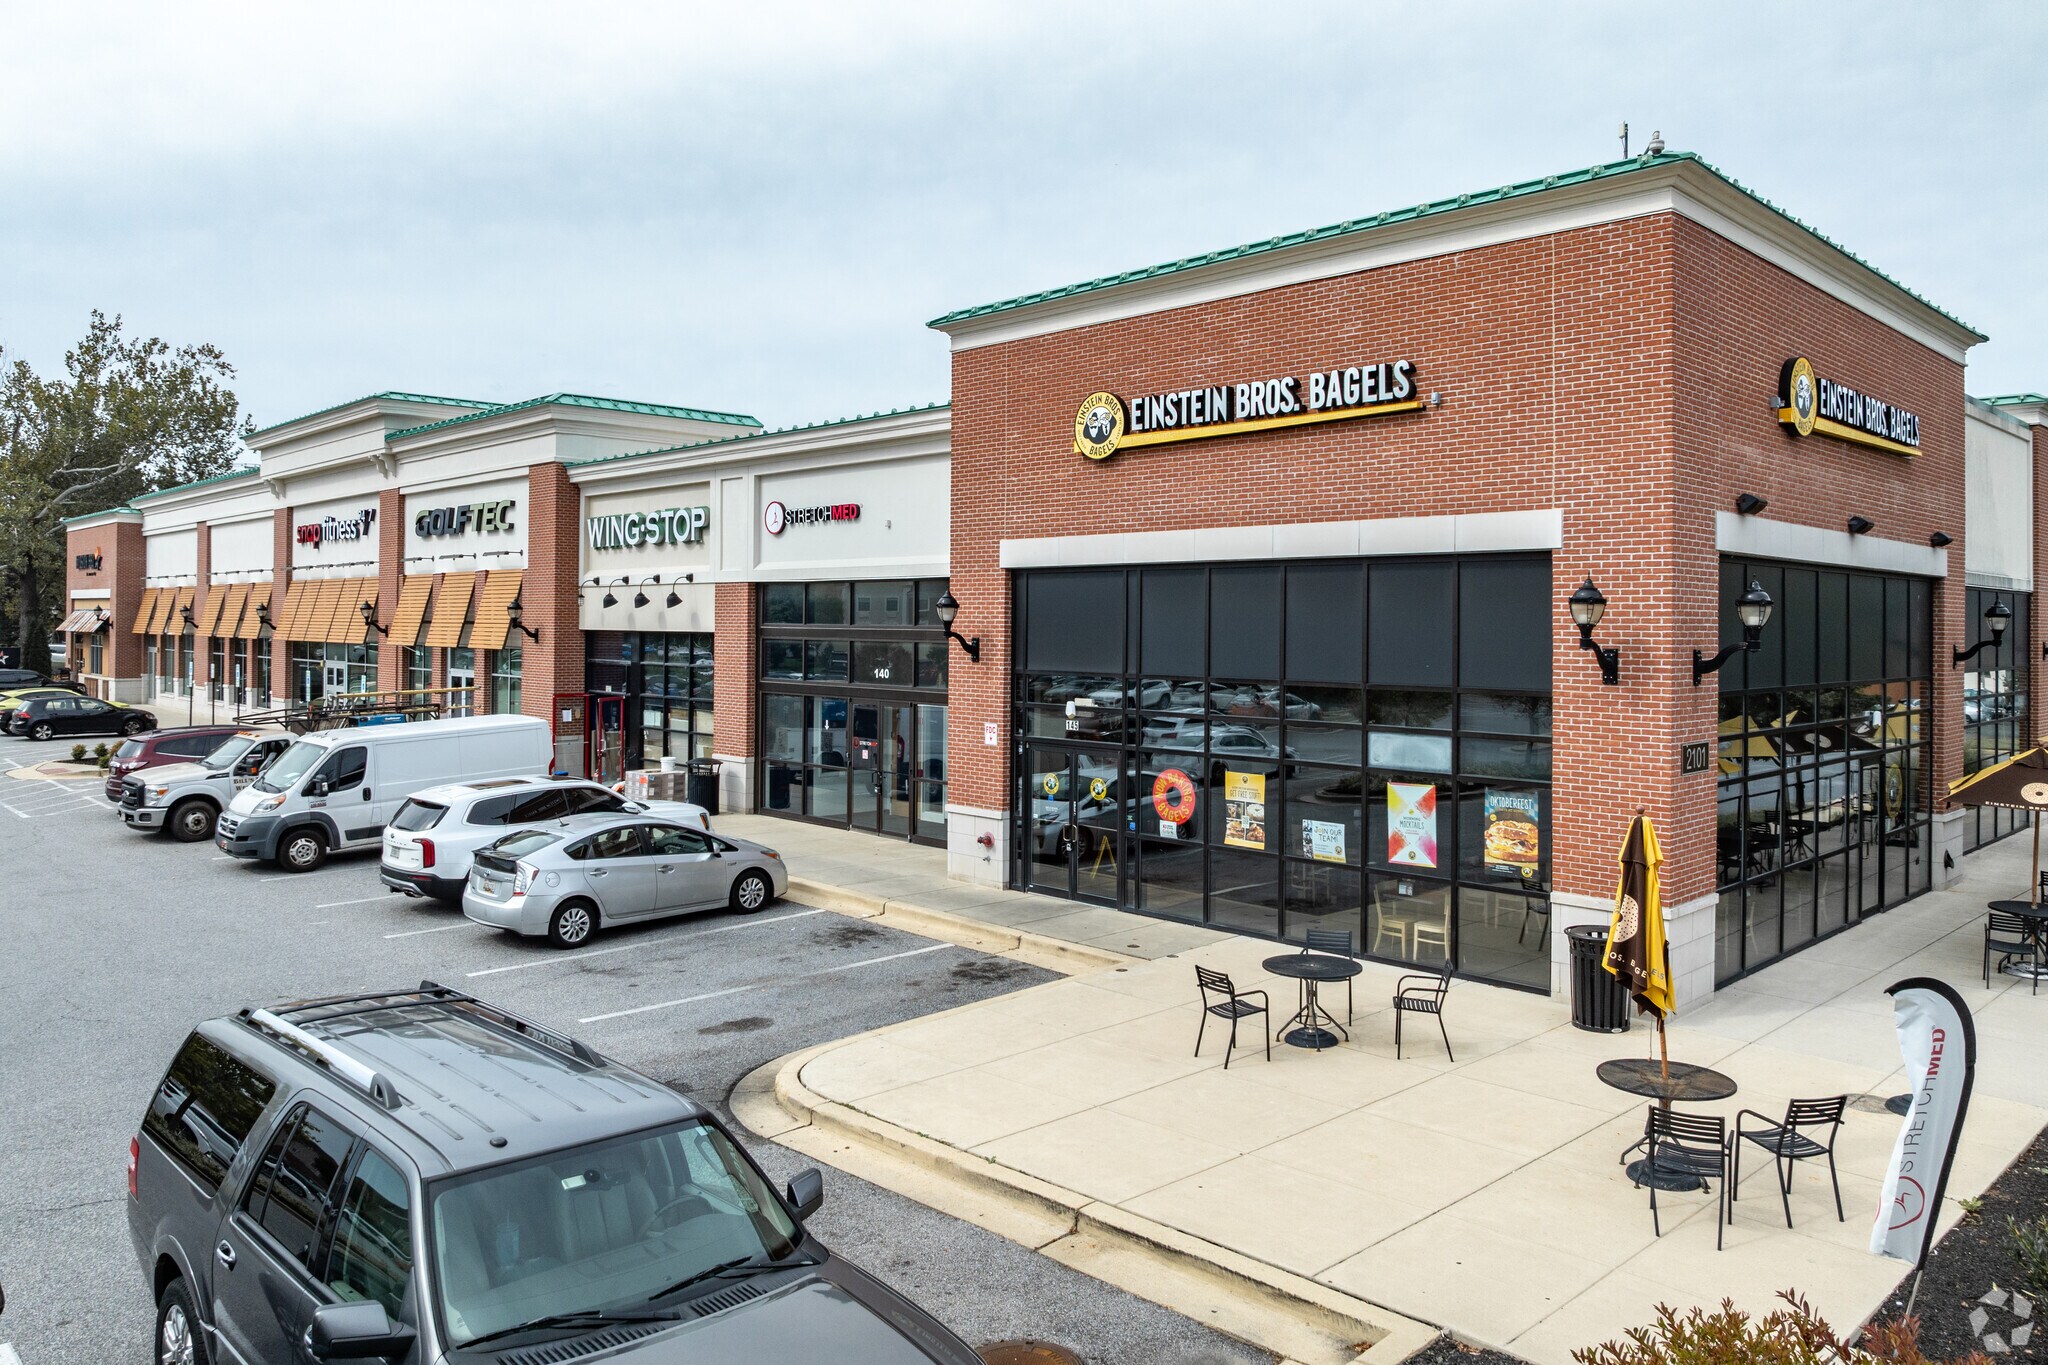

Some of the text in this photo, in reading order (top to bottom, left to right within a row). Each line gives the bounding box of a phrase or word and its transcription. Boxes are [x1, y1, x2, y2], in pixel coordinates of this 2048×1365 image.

[1131, 385, 1228, 431] EINSTEIN
[1236, 376, 1300, 419] BROS.
[1309, 359, 1411, 410] BAGELS
[1077, 394, 1121, 426] EINSTEIN BROS
[1820, 378, 1920, 447] EINSTEIN BROS. BAGELS
[1088, 439, 1115, 457] BAGELS
[415, 500, 514, 537] GOLFTEC
[784, 503, 858, 524] STRETCHMED
[297, 524, 321, 547] snap
[321, 516, 357, 541] fitness
[873, 668, 890, 679] 140
[985, 725, 996, 735] FDC
[1066, 720, 1079, 731] 145
[1686, 746, 1706, 770] 2101
[1155, 772, 1193, 803] NOW BAKING
[1157, 802, 1190, 822] BAGELS
[1490, 795, 1533, 810] OKTOBERFEST
[1985, 801, 2025, 809] EINSTEIN
[1329, 828, 1342, 836] OUR
[1399, 820, 1425, 830] MOCKTAILS
